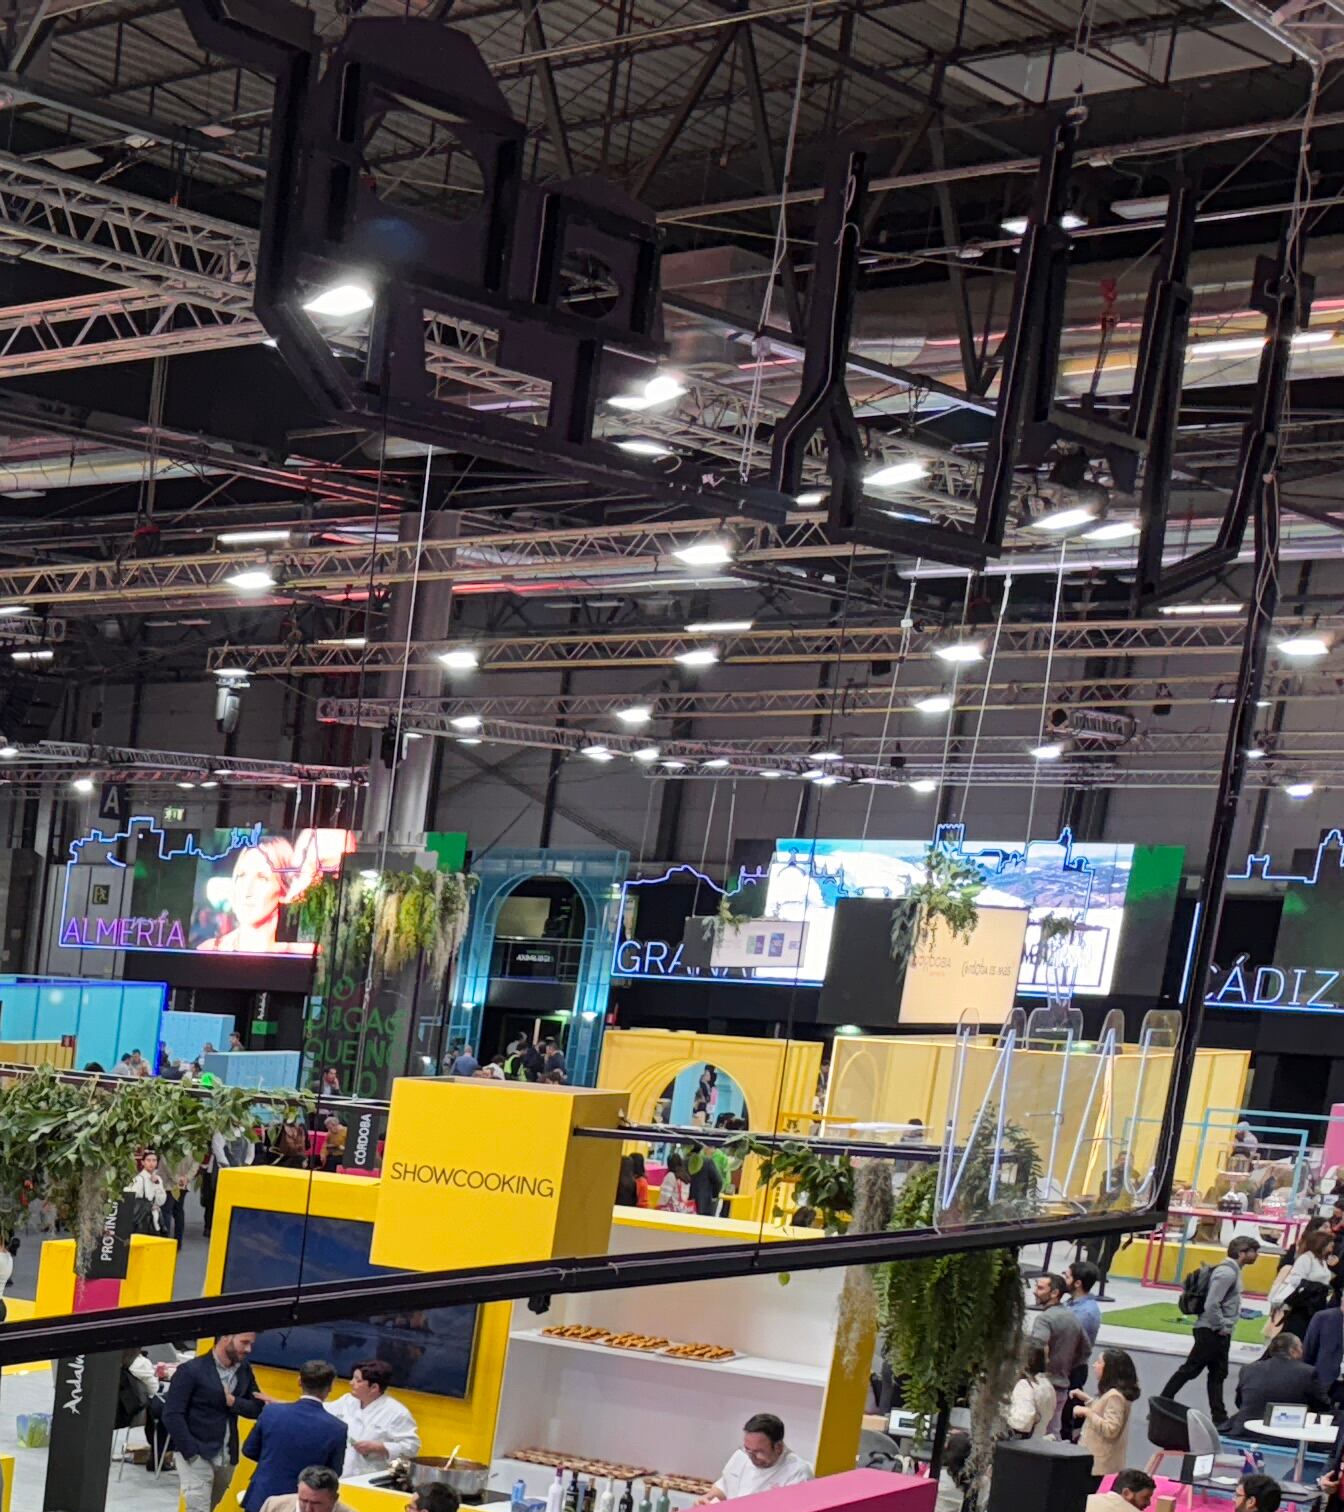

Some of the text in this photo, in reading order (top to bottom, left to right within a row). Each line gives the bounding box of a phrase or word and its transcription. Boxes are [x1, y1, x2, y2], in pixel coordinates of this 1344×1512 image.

[103, 785, 120, 815] A
[62, 912, 187, 949] ALMERÍA
[1204, 954, 1340, 1008] ÁDIZ
[354, 1113, 373, 1166] CÓRDOBA
[390, 1159, 555, 1200] SHOWCOOKING
